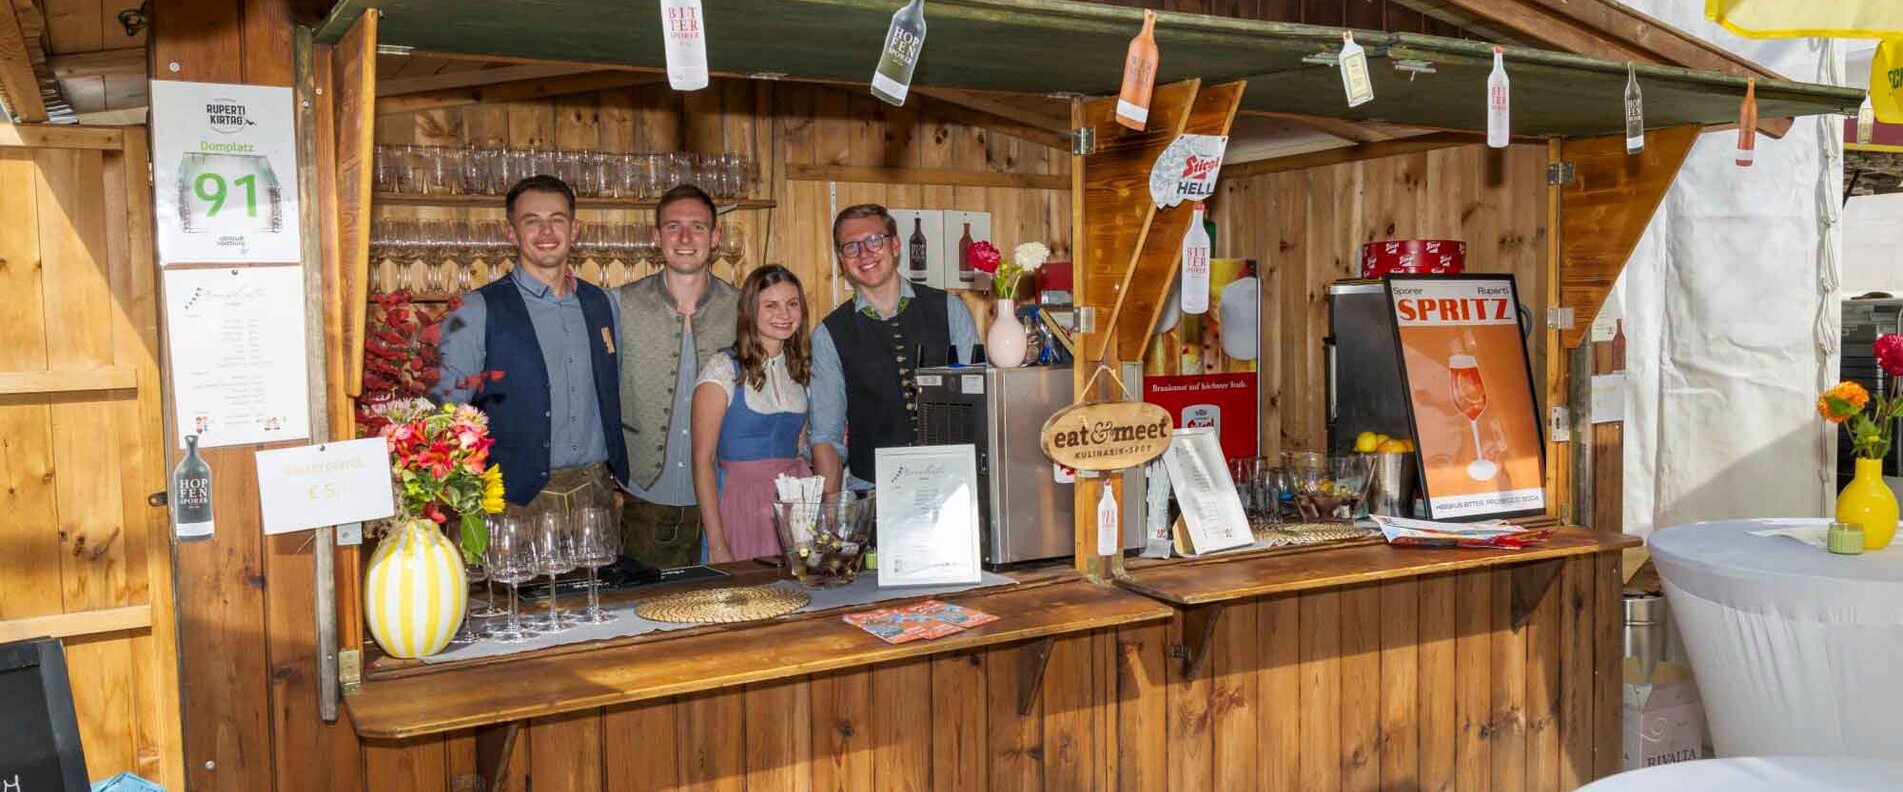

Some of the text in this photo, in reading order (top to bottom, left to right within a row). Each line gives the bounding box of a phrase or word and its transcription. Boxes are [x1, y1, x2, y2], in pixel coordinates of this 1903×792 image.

[668, 6, 697, 18] BIT
[671, 19, 698, 31] TER
[893, 26, 920, 47] HOP
[890, 36, 914, 58] FEN
[206, 104, 246, 115] RUPERTI
[210, 115, 243, 125] KIRTAG
[201, 141, 254, 153] Domplatz
[1176, 181, 1214, 195] HELL
[194, 173, 257, 217] 91
[1187, 247, 1208, 257] BIT
[1392, 286, 1423, 296] Sporer
[1397, 298, 1512, 321] SPRITZ
[180, 479, 208, 489] HOP
[180, 489, 208, 498] FEN
[1647, 748, 1697, 767] RIVALTA
